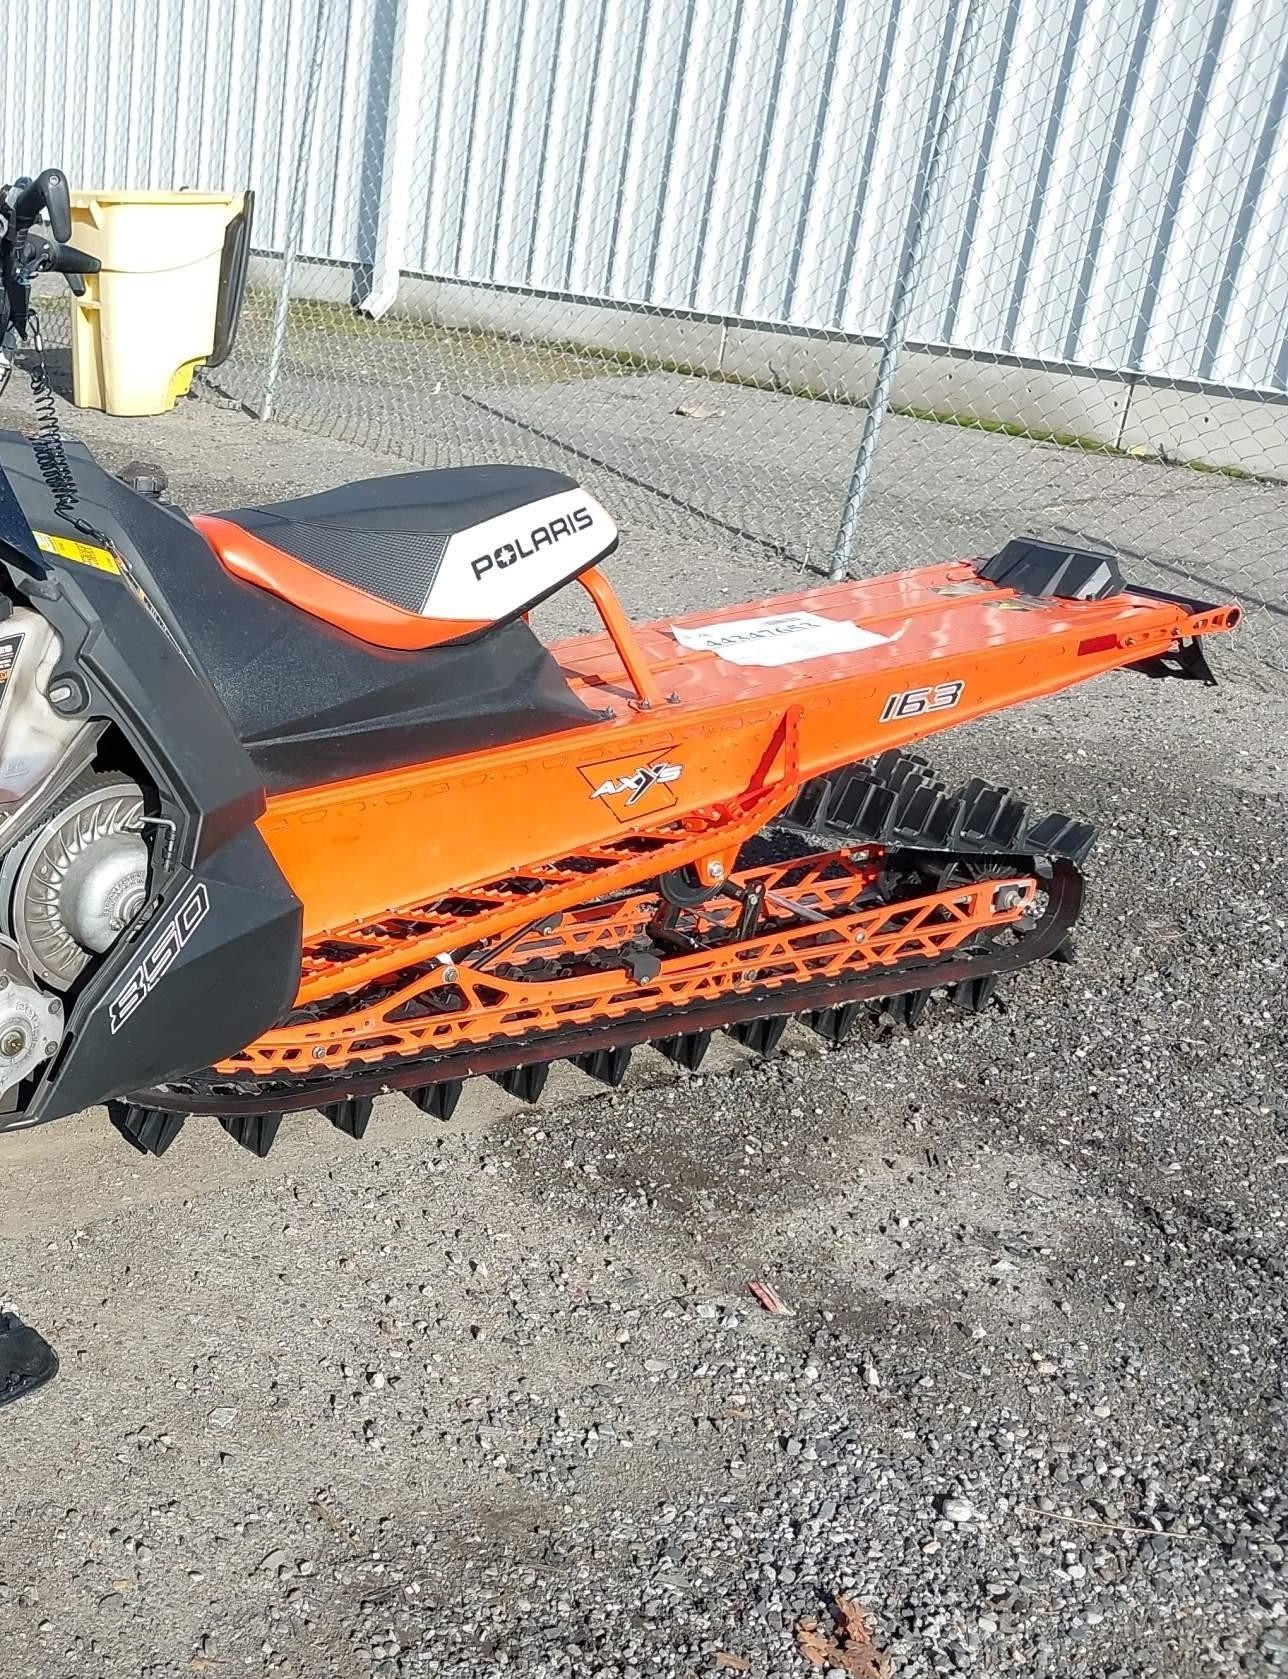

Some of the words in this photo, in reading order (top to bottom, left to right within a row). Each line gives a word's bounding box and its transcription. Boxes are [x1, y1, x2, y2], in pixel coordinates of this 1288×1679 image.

[470, 506, 593, 581] POLARIS
[878, 679, 966, 723] 163
[108, 882, 211, 1036] 850
